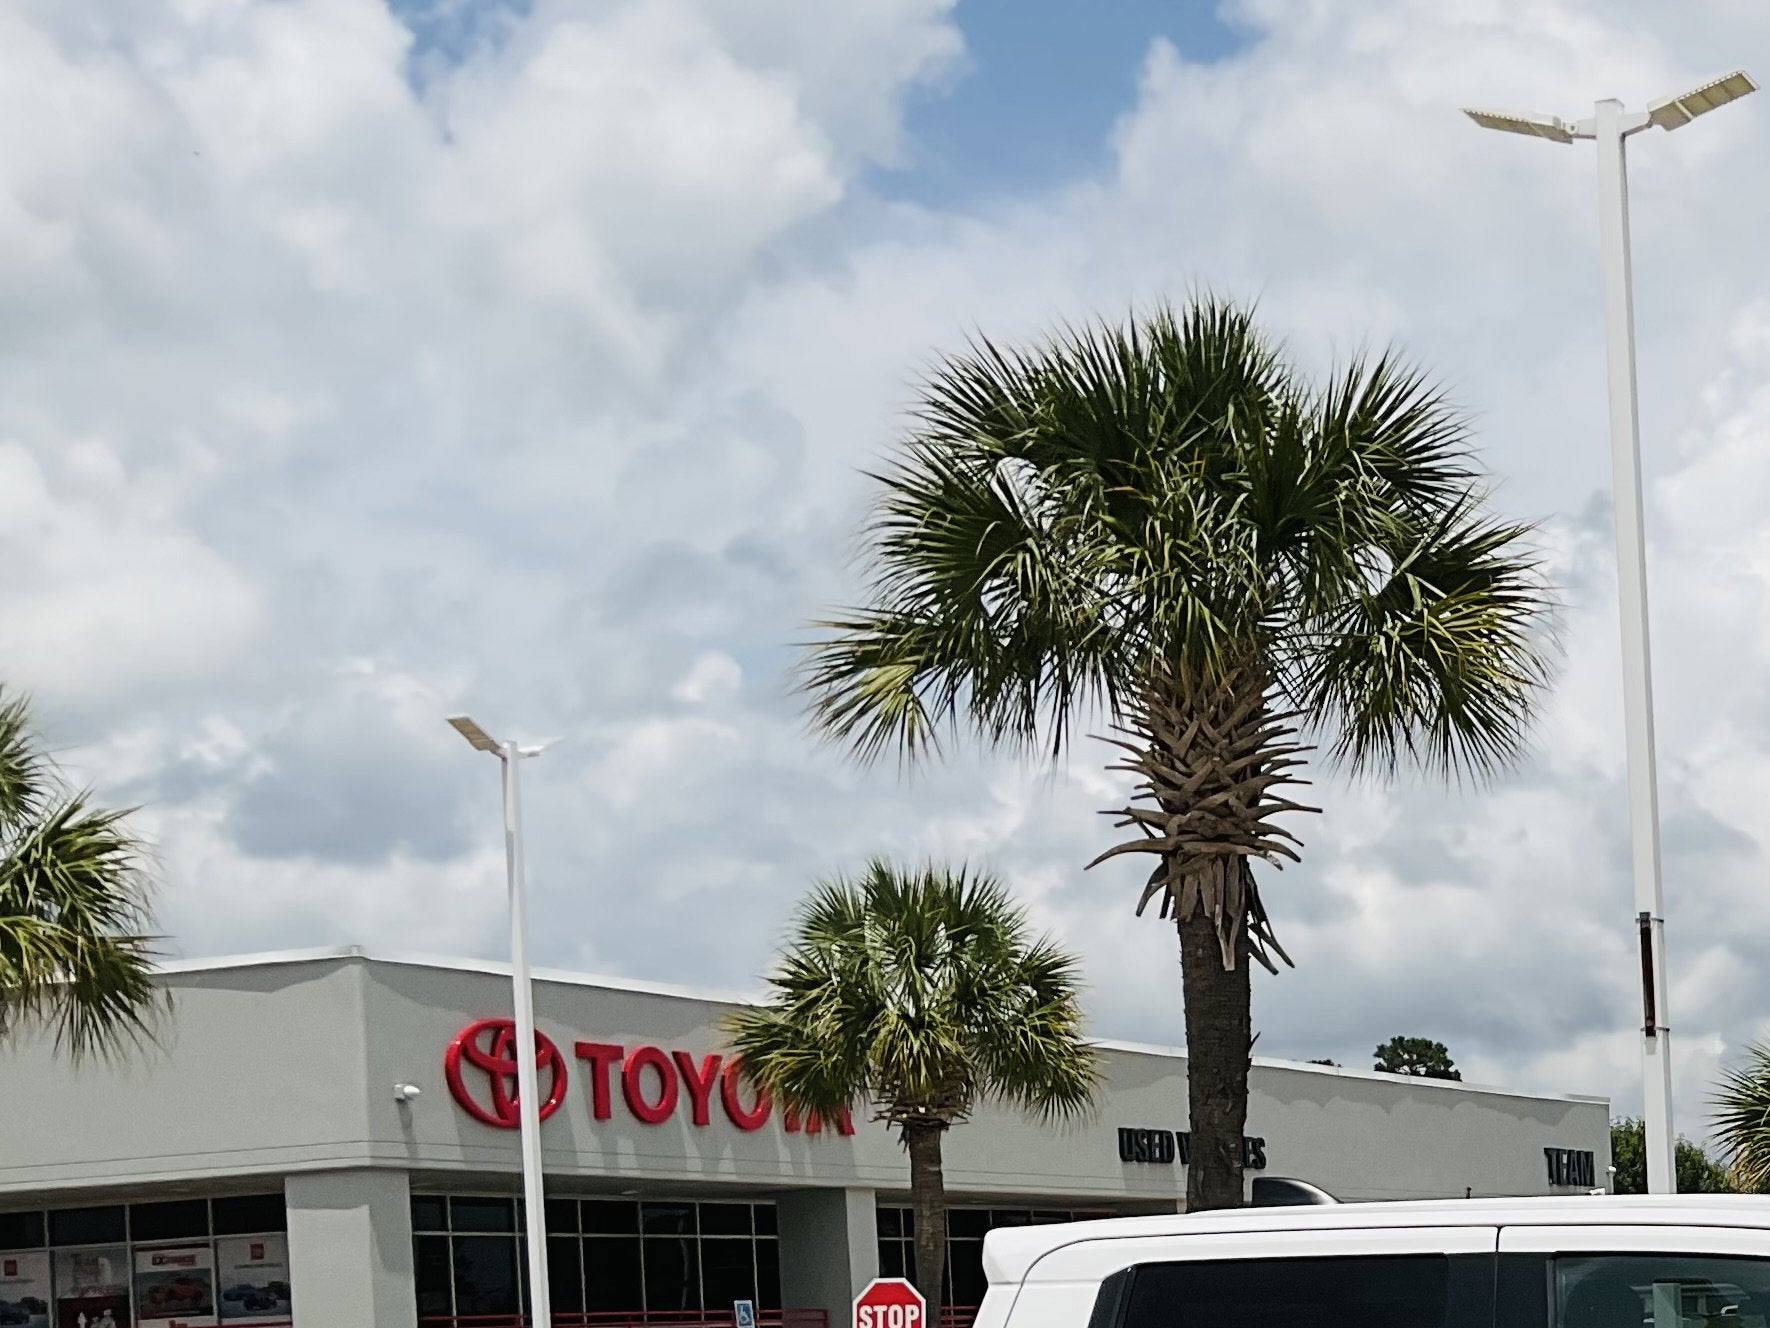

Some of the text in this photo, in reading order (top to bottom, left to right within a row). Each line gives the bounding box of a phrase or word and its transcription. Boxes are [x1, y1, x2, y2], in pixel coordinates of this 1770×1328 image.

[574, 1041, 855, 1136] TOYO
[1117, 1128, 1175, 1163] USED
[1544, 1147, 1595, 1186] TEAM
